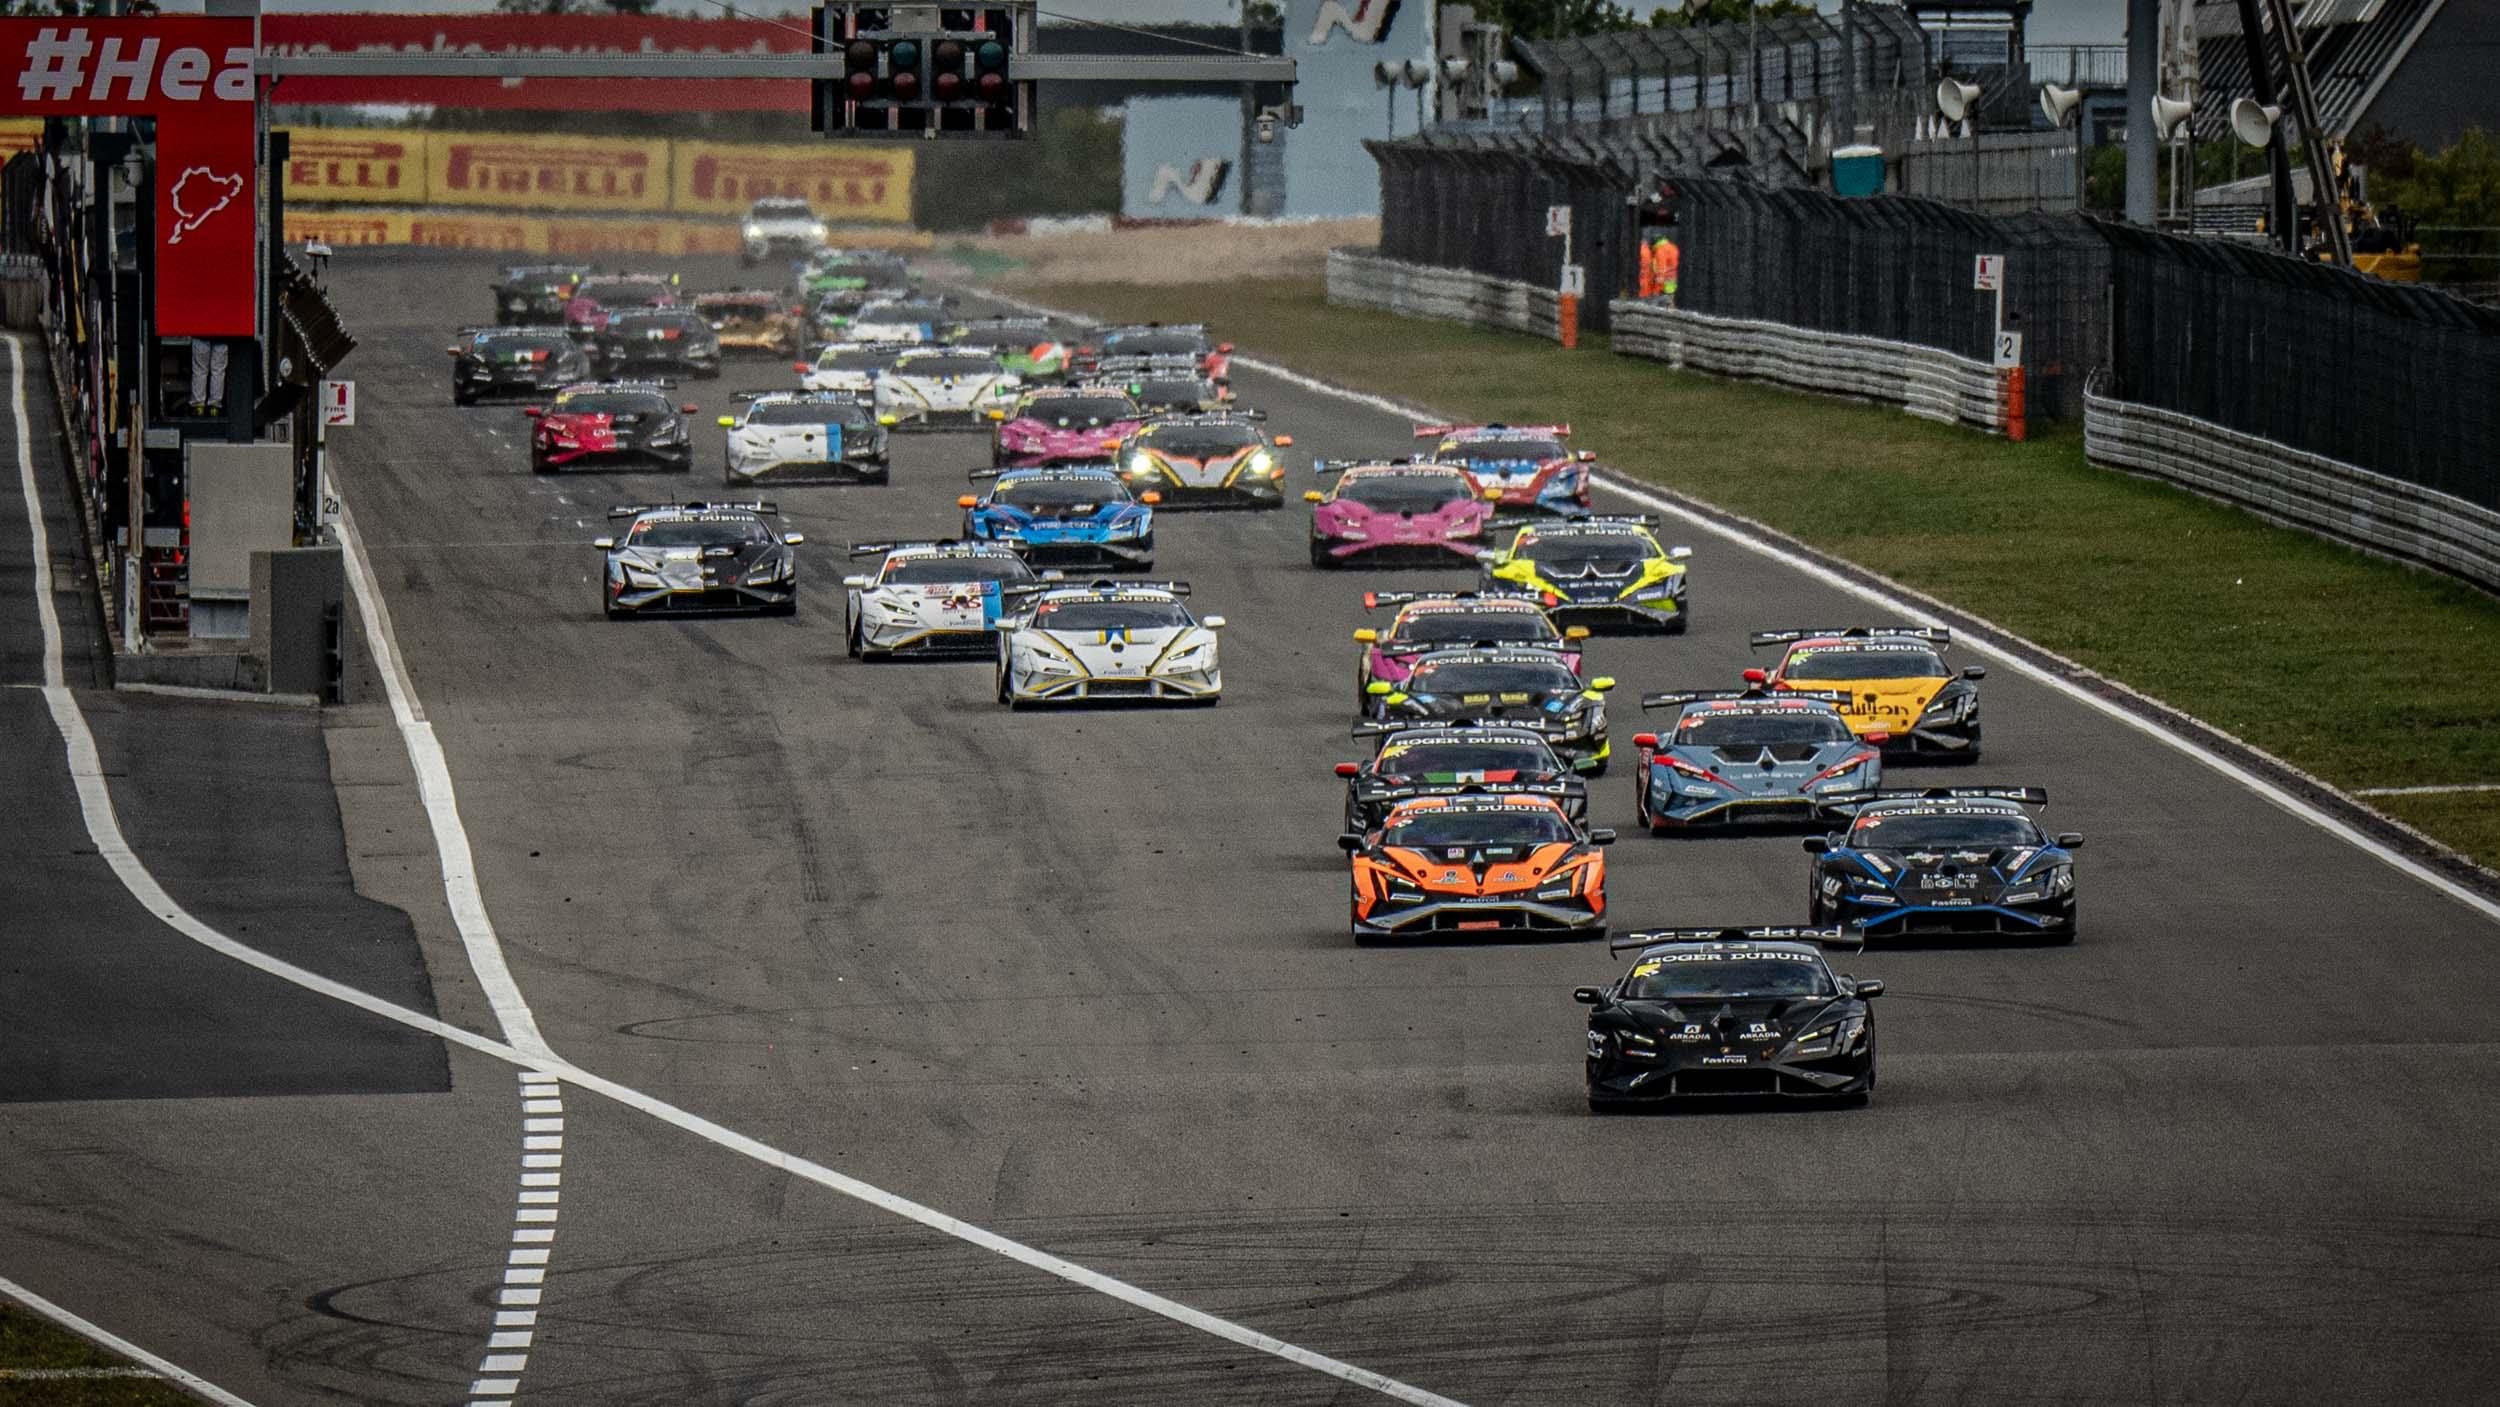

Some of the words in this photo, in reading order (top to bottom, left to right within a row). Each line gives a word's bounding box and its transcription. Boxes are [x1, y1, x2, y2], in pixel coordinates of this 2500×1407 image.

[18, 28, 255, 101] #Hea
[2003, 336, 2013, 359] 2
[324, 497, 340, 515] 2a
[1401, 804, 1468, 815] ROGER
[1476, 803, 1550, 813] DUBUIS
[1869, 808, 1937, 817] ROGER
[1944, 807, 2019, 816] DUBUIS
[1647, 953, 1722, 963] ROGER
[1730, 952, 1813, 962] DUBUIS
